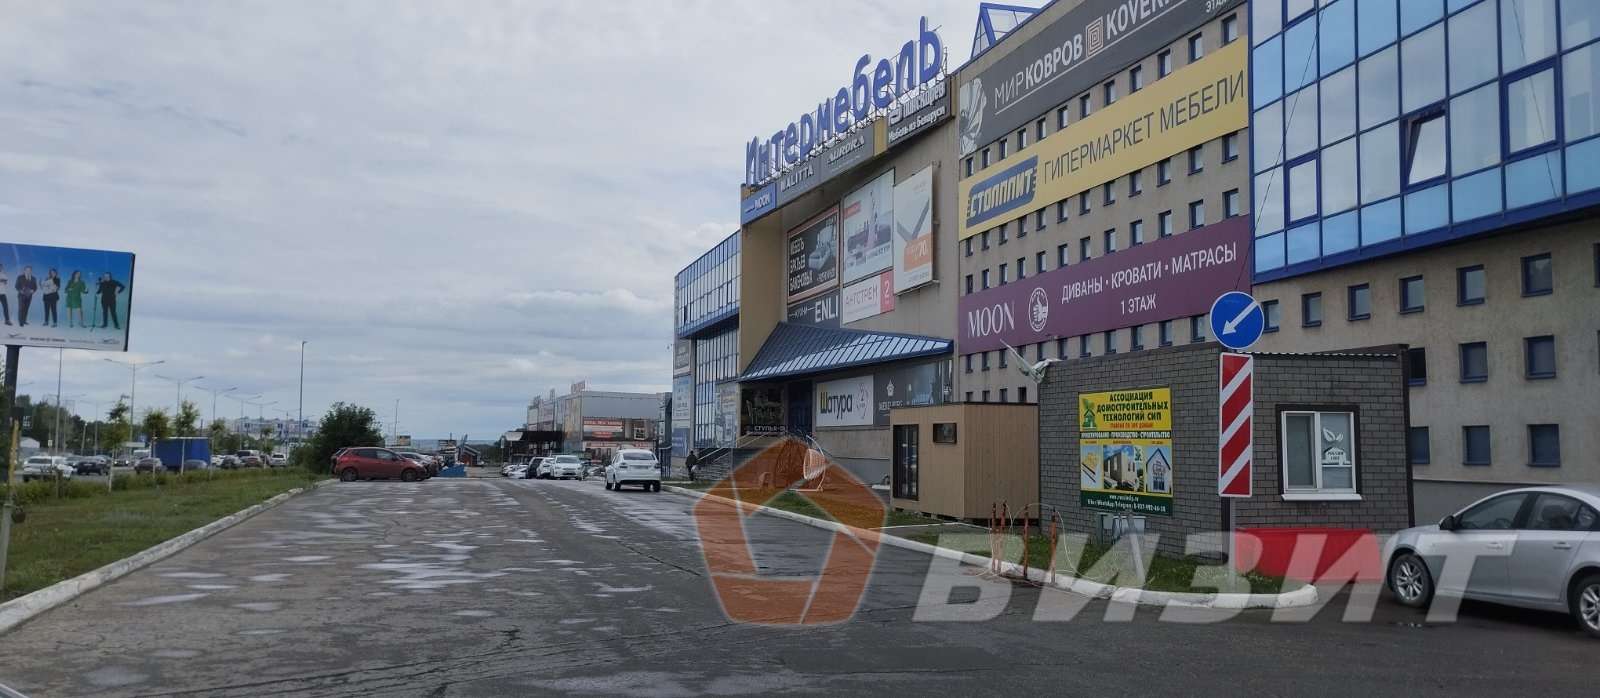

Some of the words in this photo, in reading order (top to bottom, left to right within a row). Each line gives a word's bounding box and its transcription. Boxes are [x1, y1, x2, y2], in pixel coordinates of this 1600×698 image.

[1044, 112, 1155, 184] ГИПЕРМАРКЕТ
[1160, 70, 1244, 132] МЕБЕЛИ
[1061, 278, 1103, 304] ДИВАНЫ
[1111, 262, 1162, 289] КРОВАТИ
[1172, 241, 1237, 275] МАТРАСЫ
[815, 295, 839, 323] ENLI
[1120, 299, 1126, 316] 1
[1128, 293, 1156, 314] ЭТАЖ
[967, 300, 1015, 339] MOON
[820, 392, 853, 420] Шатура
[1096, 401, 1168, 413] ДОМОСТРОИТЕЛЬНЫХ
[1109, 391, 1153, 402] АССОЦИАЦИЯ
[1103, 411, 1145, 422] ТЕХНОЛОГИЙ
[1147, 411, 1162, 421] СИП
